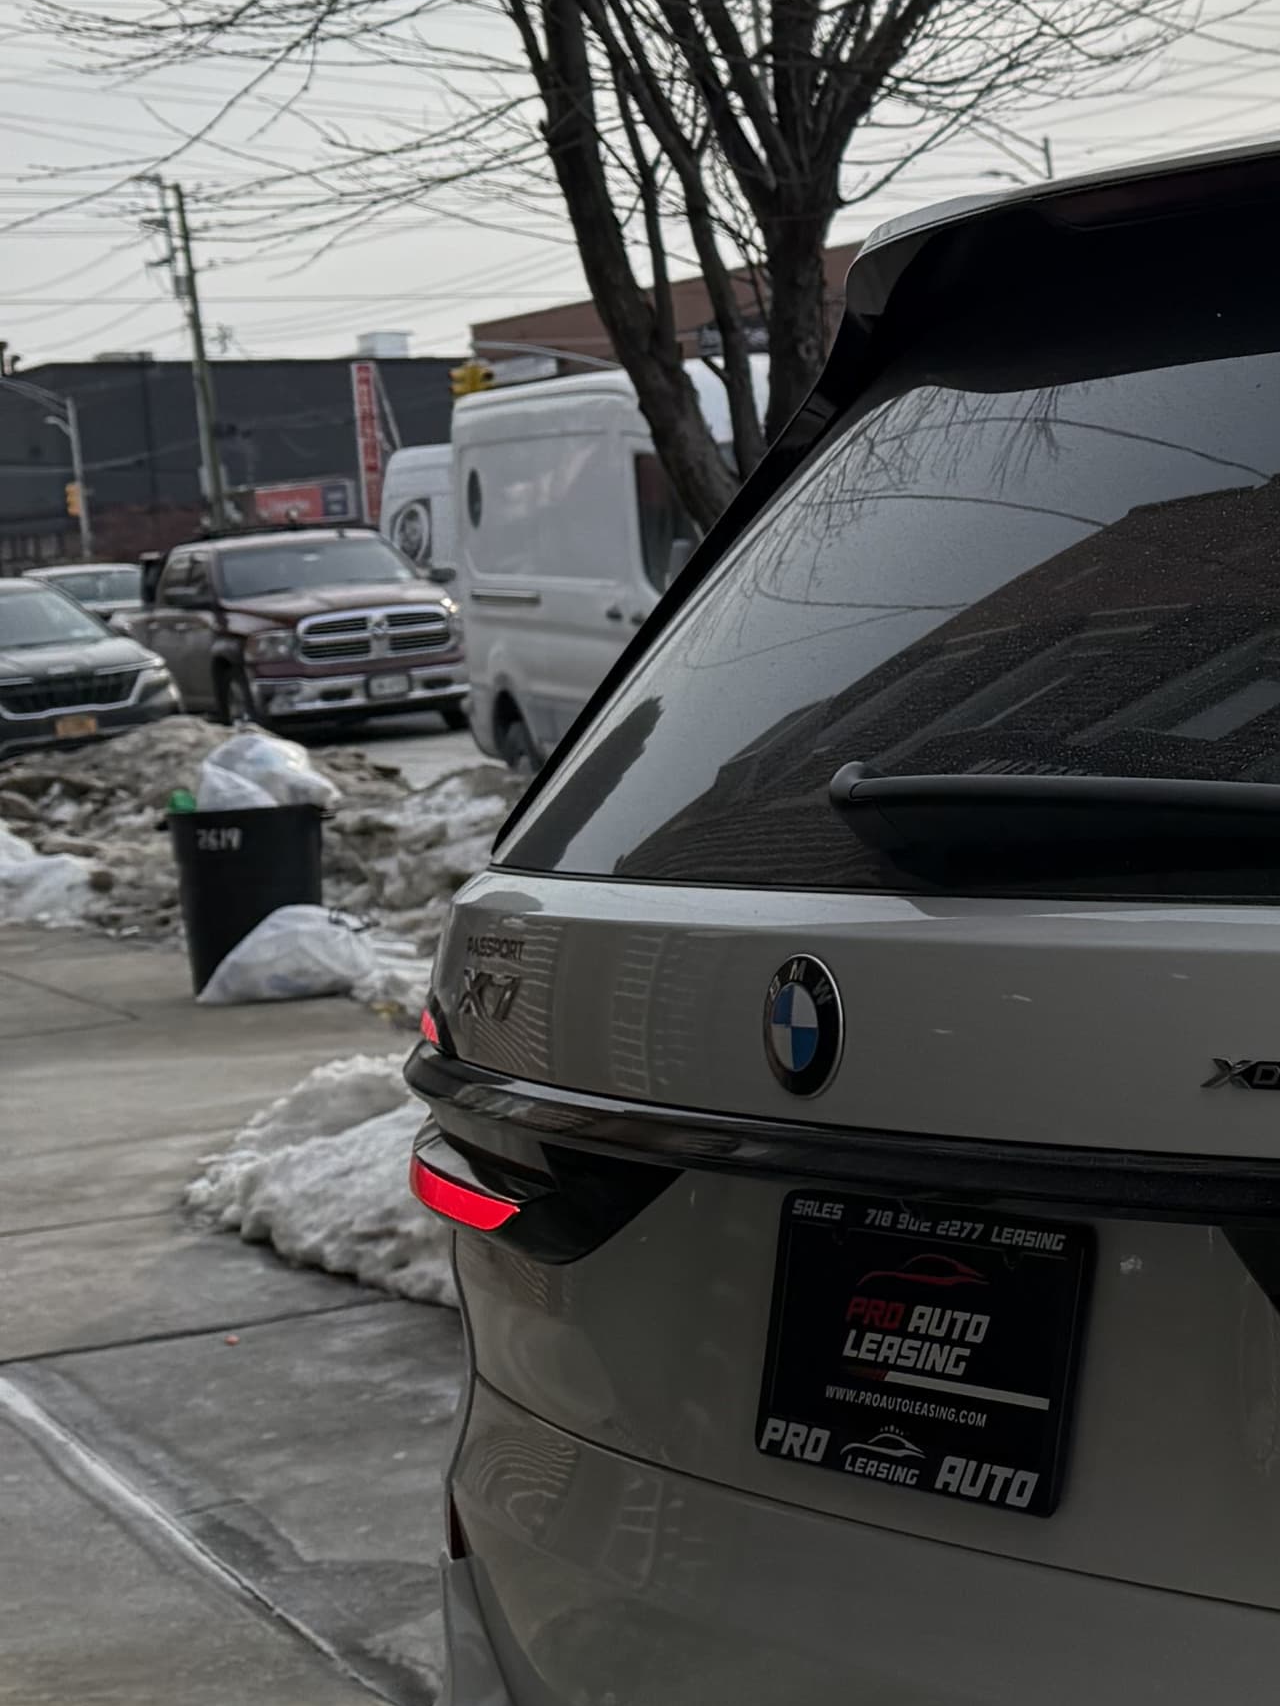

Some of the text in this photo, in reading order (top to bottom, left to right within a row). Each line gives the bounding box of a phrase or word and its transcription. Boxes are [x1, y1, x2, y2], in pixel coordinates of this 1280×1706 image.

[459, 969, 521, 1022] X7
[769, 959, 835, 1006] BMW
[791, 1198, 845, 1221] SALES
[864, 1207, 894, 1228] 718
[935, 1220, 985, 1241] 2277
[990, 1225, 1067, 1252] LEASING
[845, 1295, 991, 1344] PRO AUTO
[842, 1328, 972, 1377] LEASING
[825, 1384, 988, 1429] WWW.PROAUTOLEASING.COM
[759, 1418, 1040, 1509] PRO LEASING AUTO
